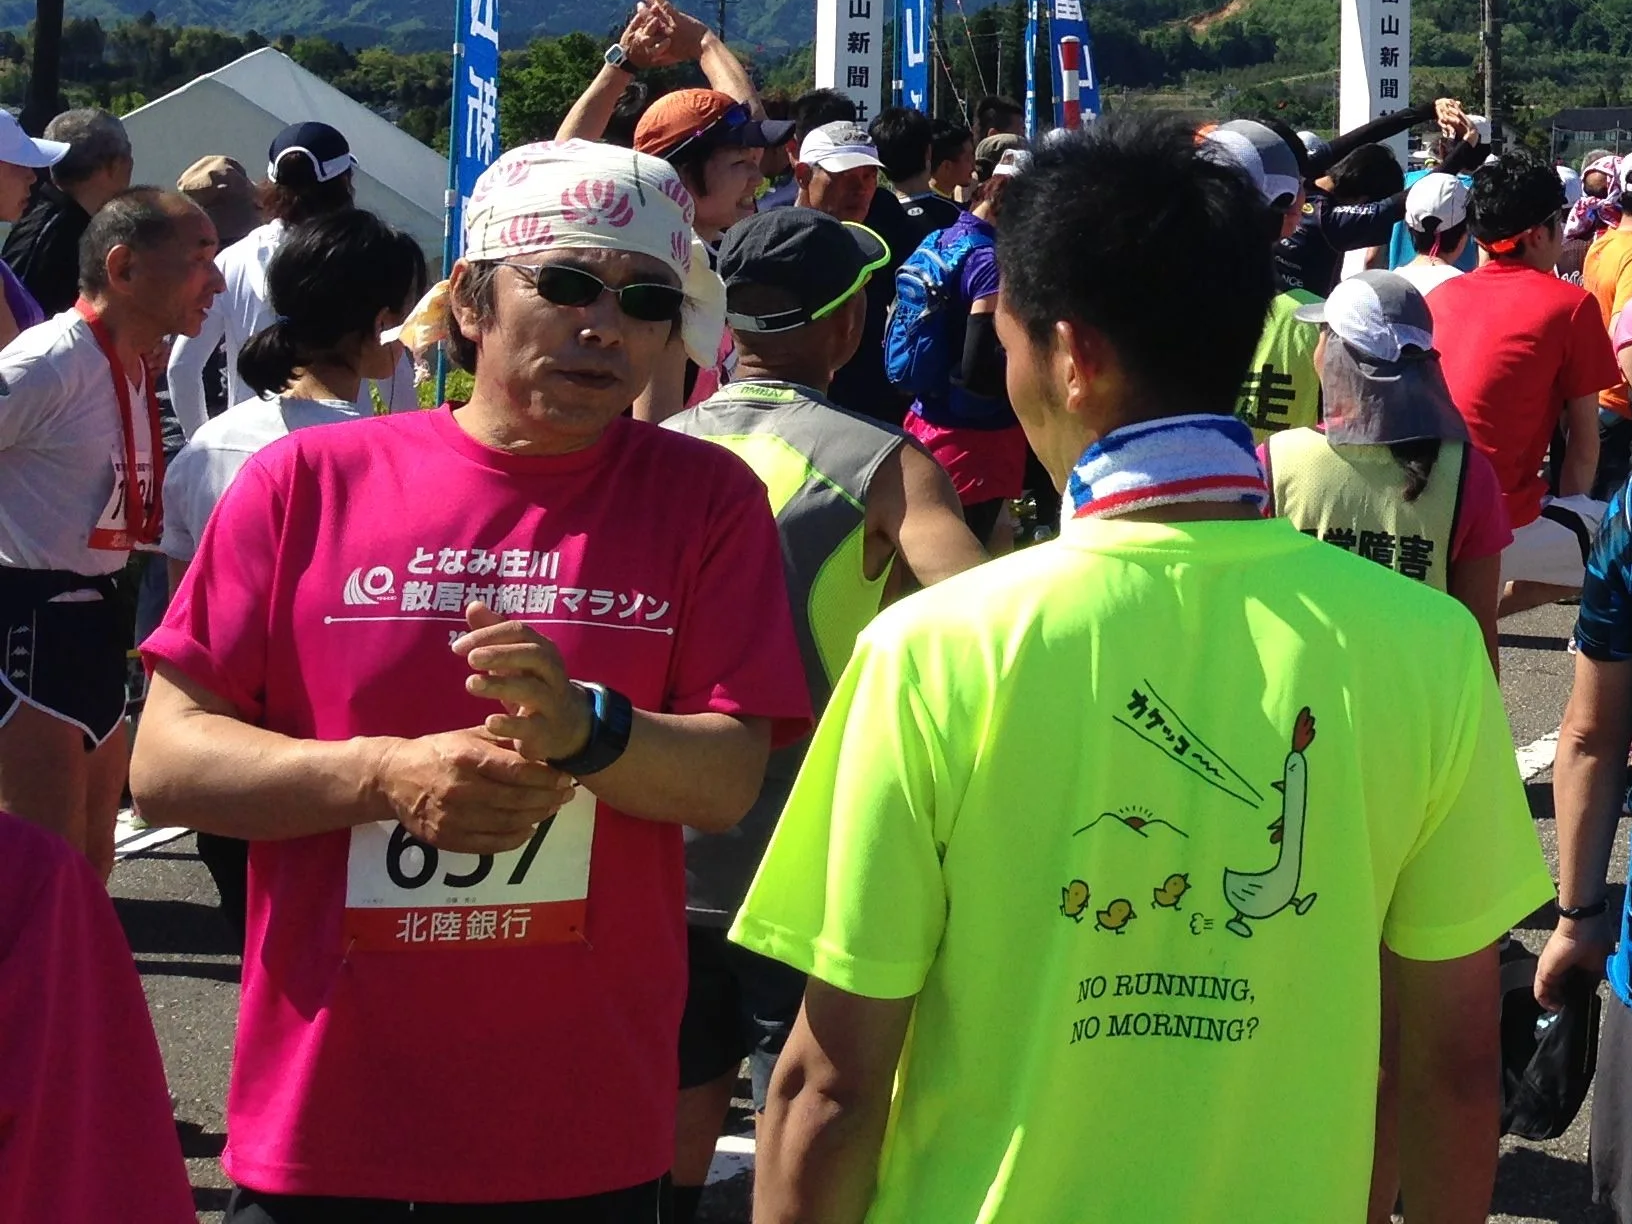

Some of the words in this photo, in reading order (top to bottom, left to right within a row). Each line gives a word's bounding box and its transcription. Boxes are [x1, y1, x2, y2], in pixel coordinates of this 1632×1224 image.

[407, 547, 560, 580] となみ庄川
[396, 908, 532, 943] 北陸銀行
[1076, 975, 1107, 1004] NO
[1112, 972, 1255, 1004] RUNNING,
[1070, 1015, 1100, 1045] NO
[1105, 1012, 1260, 1042] MORNING?
